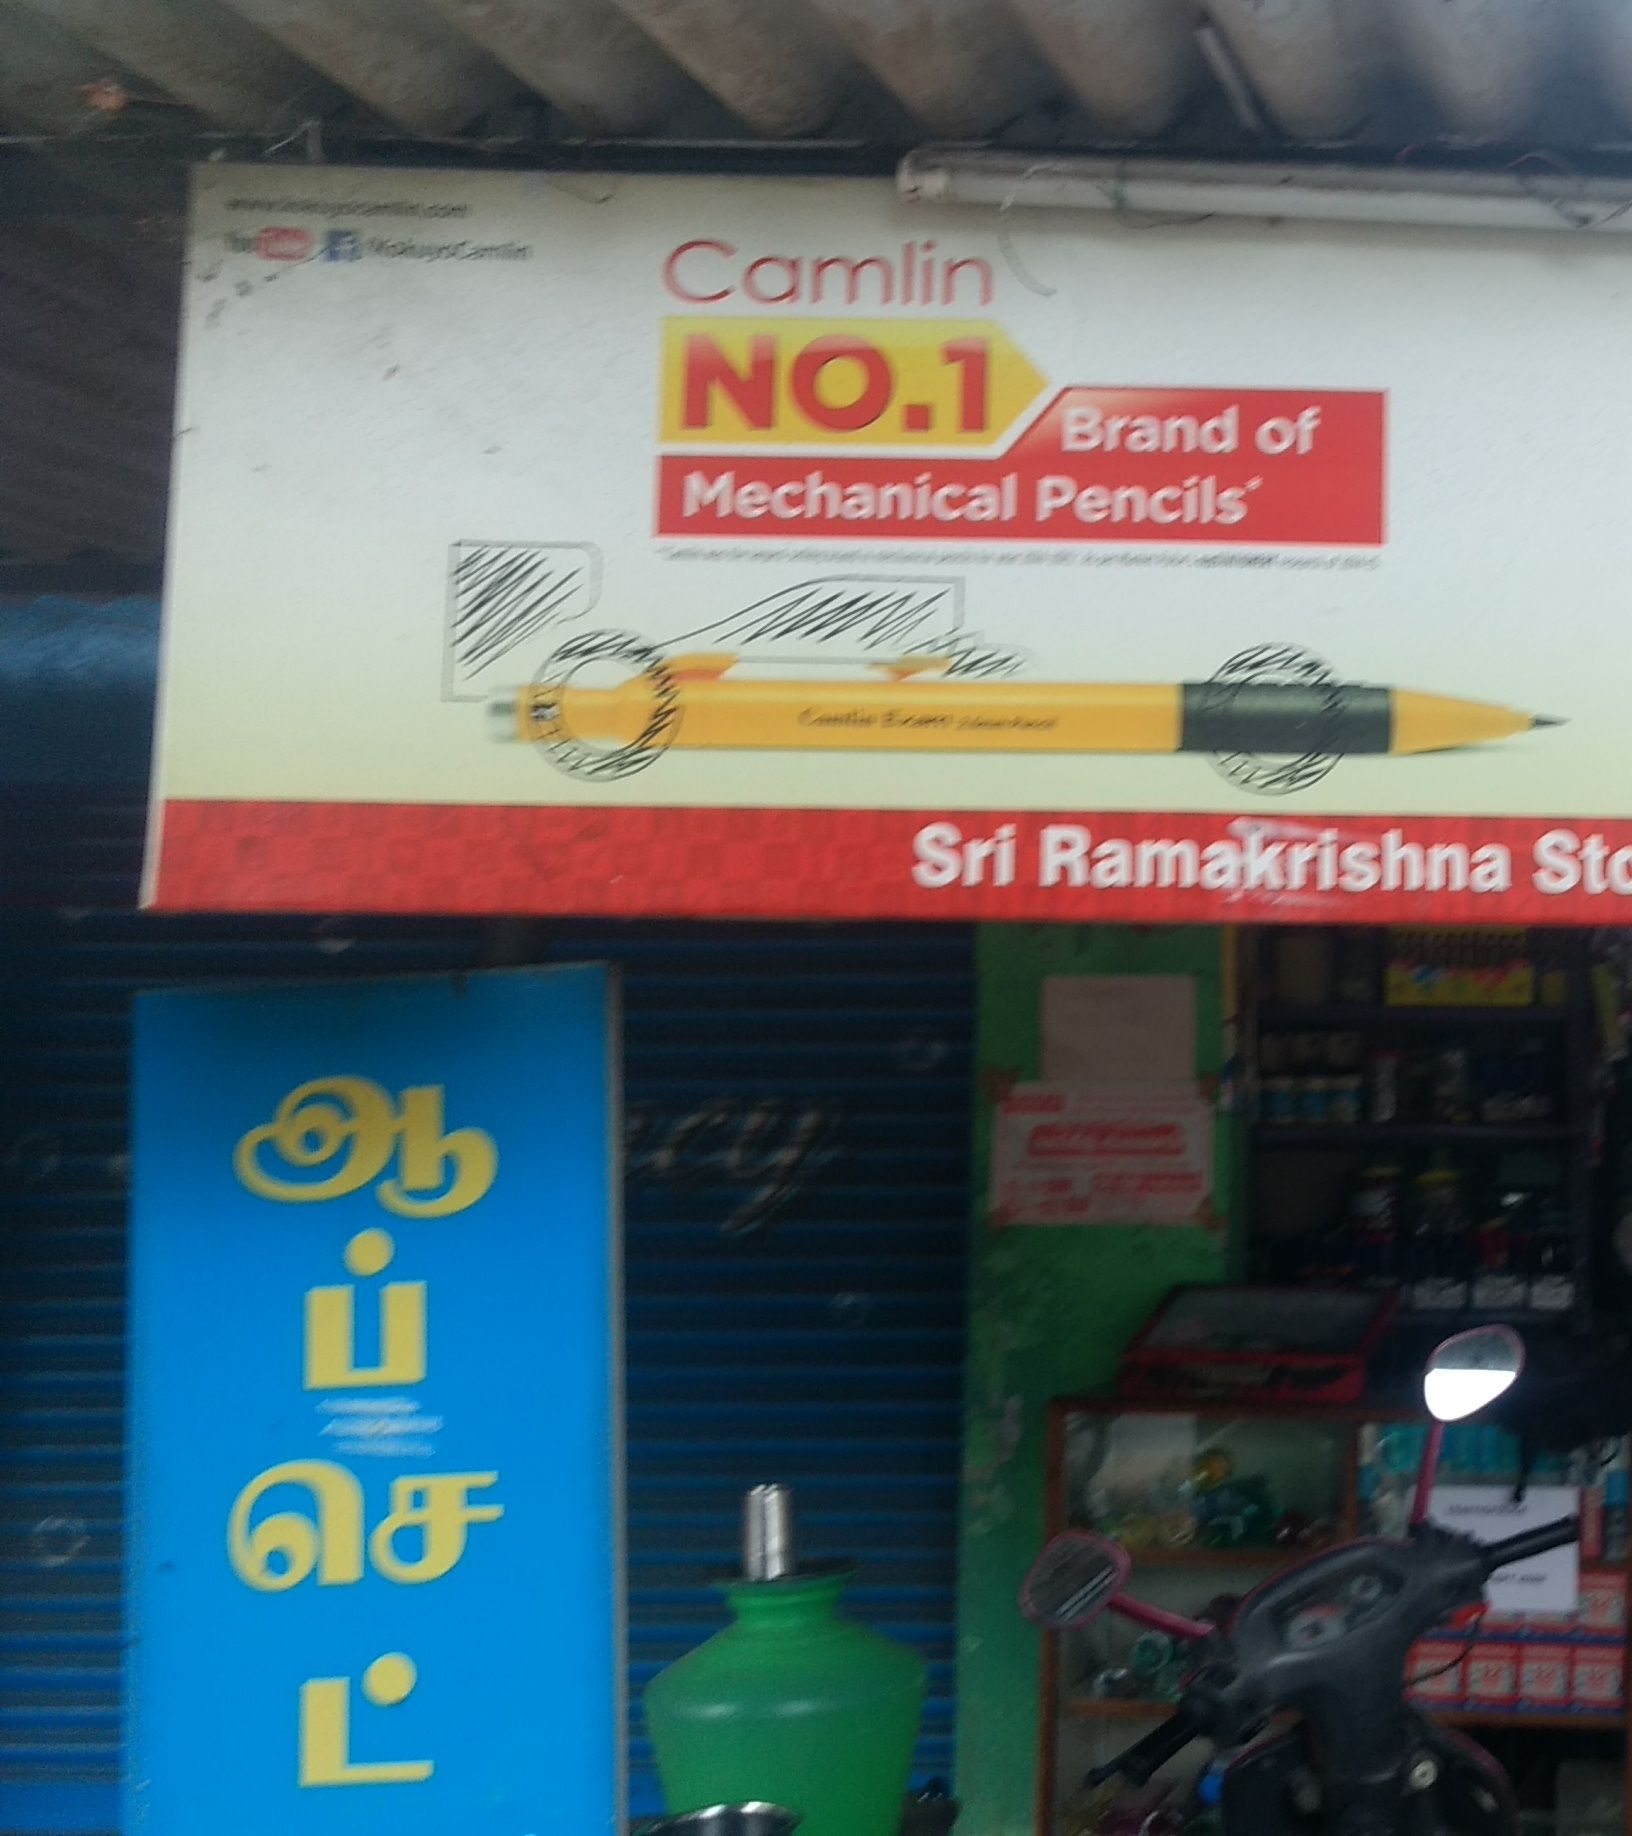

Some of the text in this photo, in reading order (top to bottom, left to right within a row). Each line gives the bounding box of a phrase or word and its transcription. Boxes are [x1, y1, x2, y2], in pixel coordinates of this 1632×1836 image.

[661, 238, 994, 307] Camlin
[680, 332, 991, 435] NO.1
[1060, 405, 1322, 456] Brand of
[682, 469, 1018, 523] Mechanical
[912, 821, 1018, 890] Sri
[1037, 823, 1514, 894] Ramakrishna
